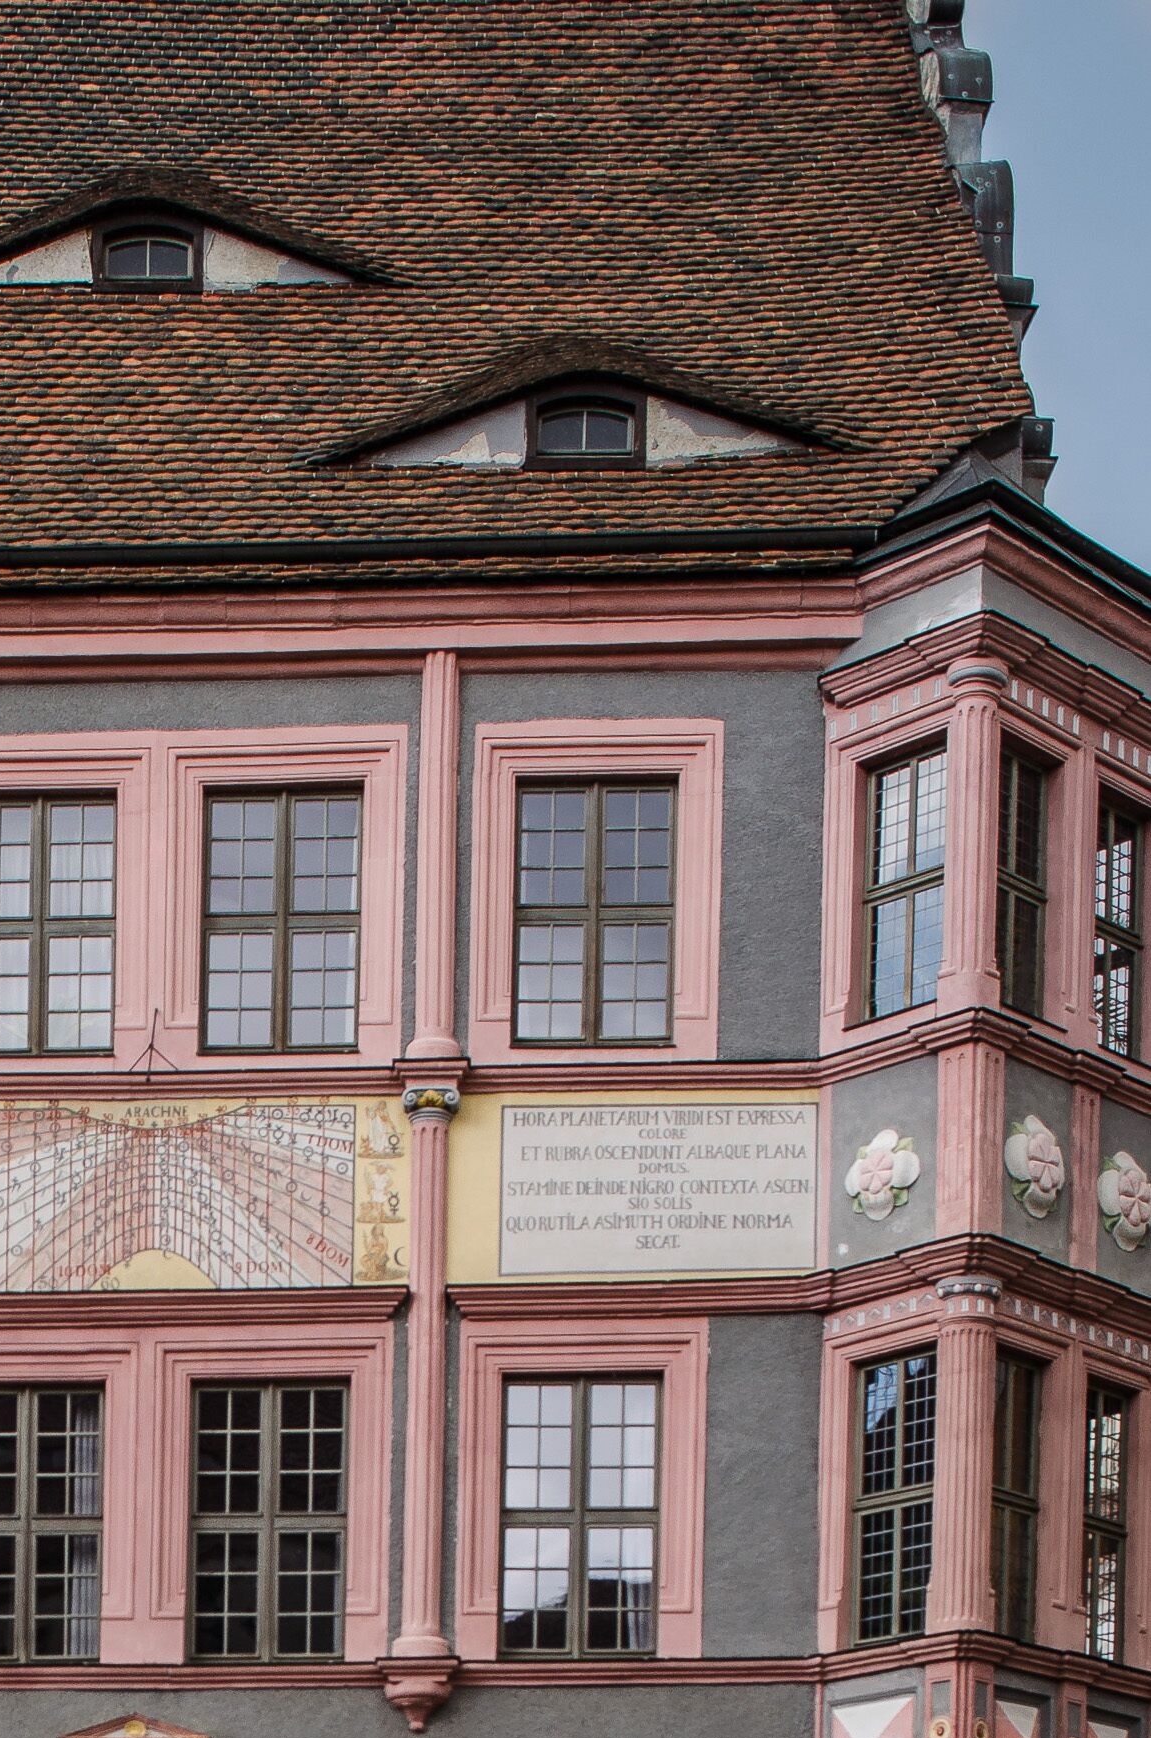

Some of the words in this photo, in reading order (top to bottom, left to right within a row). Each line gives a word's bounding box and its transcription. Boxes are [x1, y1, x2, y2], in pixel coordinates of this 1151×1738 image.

[124, 1105, 189, 1118] ARACHNE
[512, 1111, 558, 1127] HORA
[560, 1110, 659, 1127] PLANETARUM
[663, 1110, 703, 1126] VIRIDI
[707, 1110, 734, 1126] EST
[737, 1109, 806, 1125] EXPRESSA
[638, 1128, 688, 1140] COLORE
[316, 1135, 353, 1154] DOM
[520, 1146, 542, 1161] ET
[545, 1146, 591, 1161] RUBRA
[594, 1144, 684, 1161] OSCENDUNT
[756, 1144, 807, 1159] PLANA
[680, 1179, 760, 1195] CONTEXTA
[505, 1216, 536, 1234] QUO
[733, 1214, 794, 1229] NORMA
[306, 1233, 316, 1245] 8
[315, 1237, 351, 1269] DOM
[246, 1261, 283, 1274] DOM
